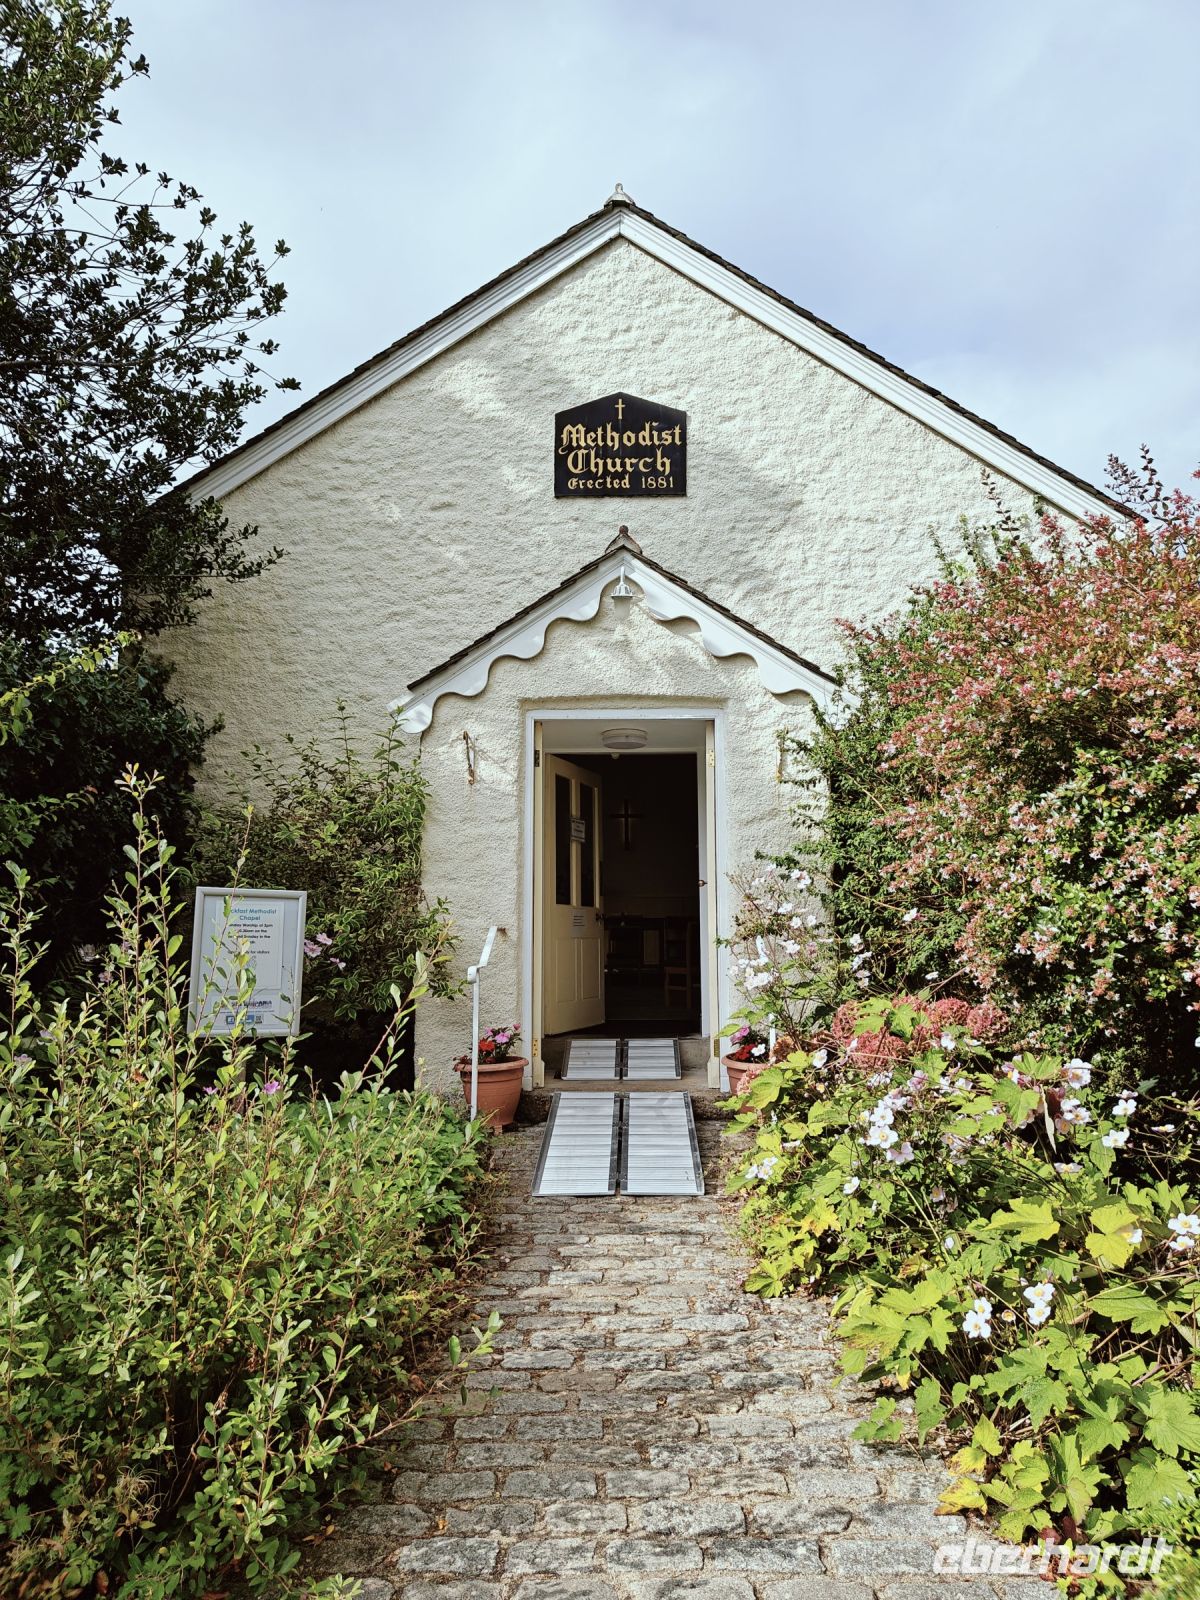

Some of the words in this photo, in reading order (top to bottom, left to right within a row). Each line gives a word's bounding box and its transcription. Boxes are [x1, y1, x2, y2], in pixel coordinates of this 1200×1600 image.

[558, 421, 682, 455] Methodist
[567, 446, 671, 477] Church
[567, 473, 631, 490] Erected
[641, 476, 674, 489] 1881
